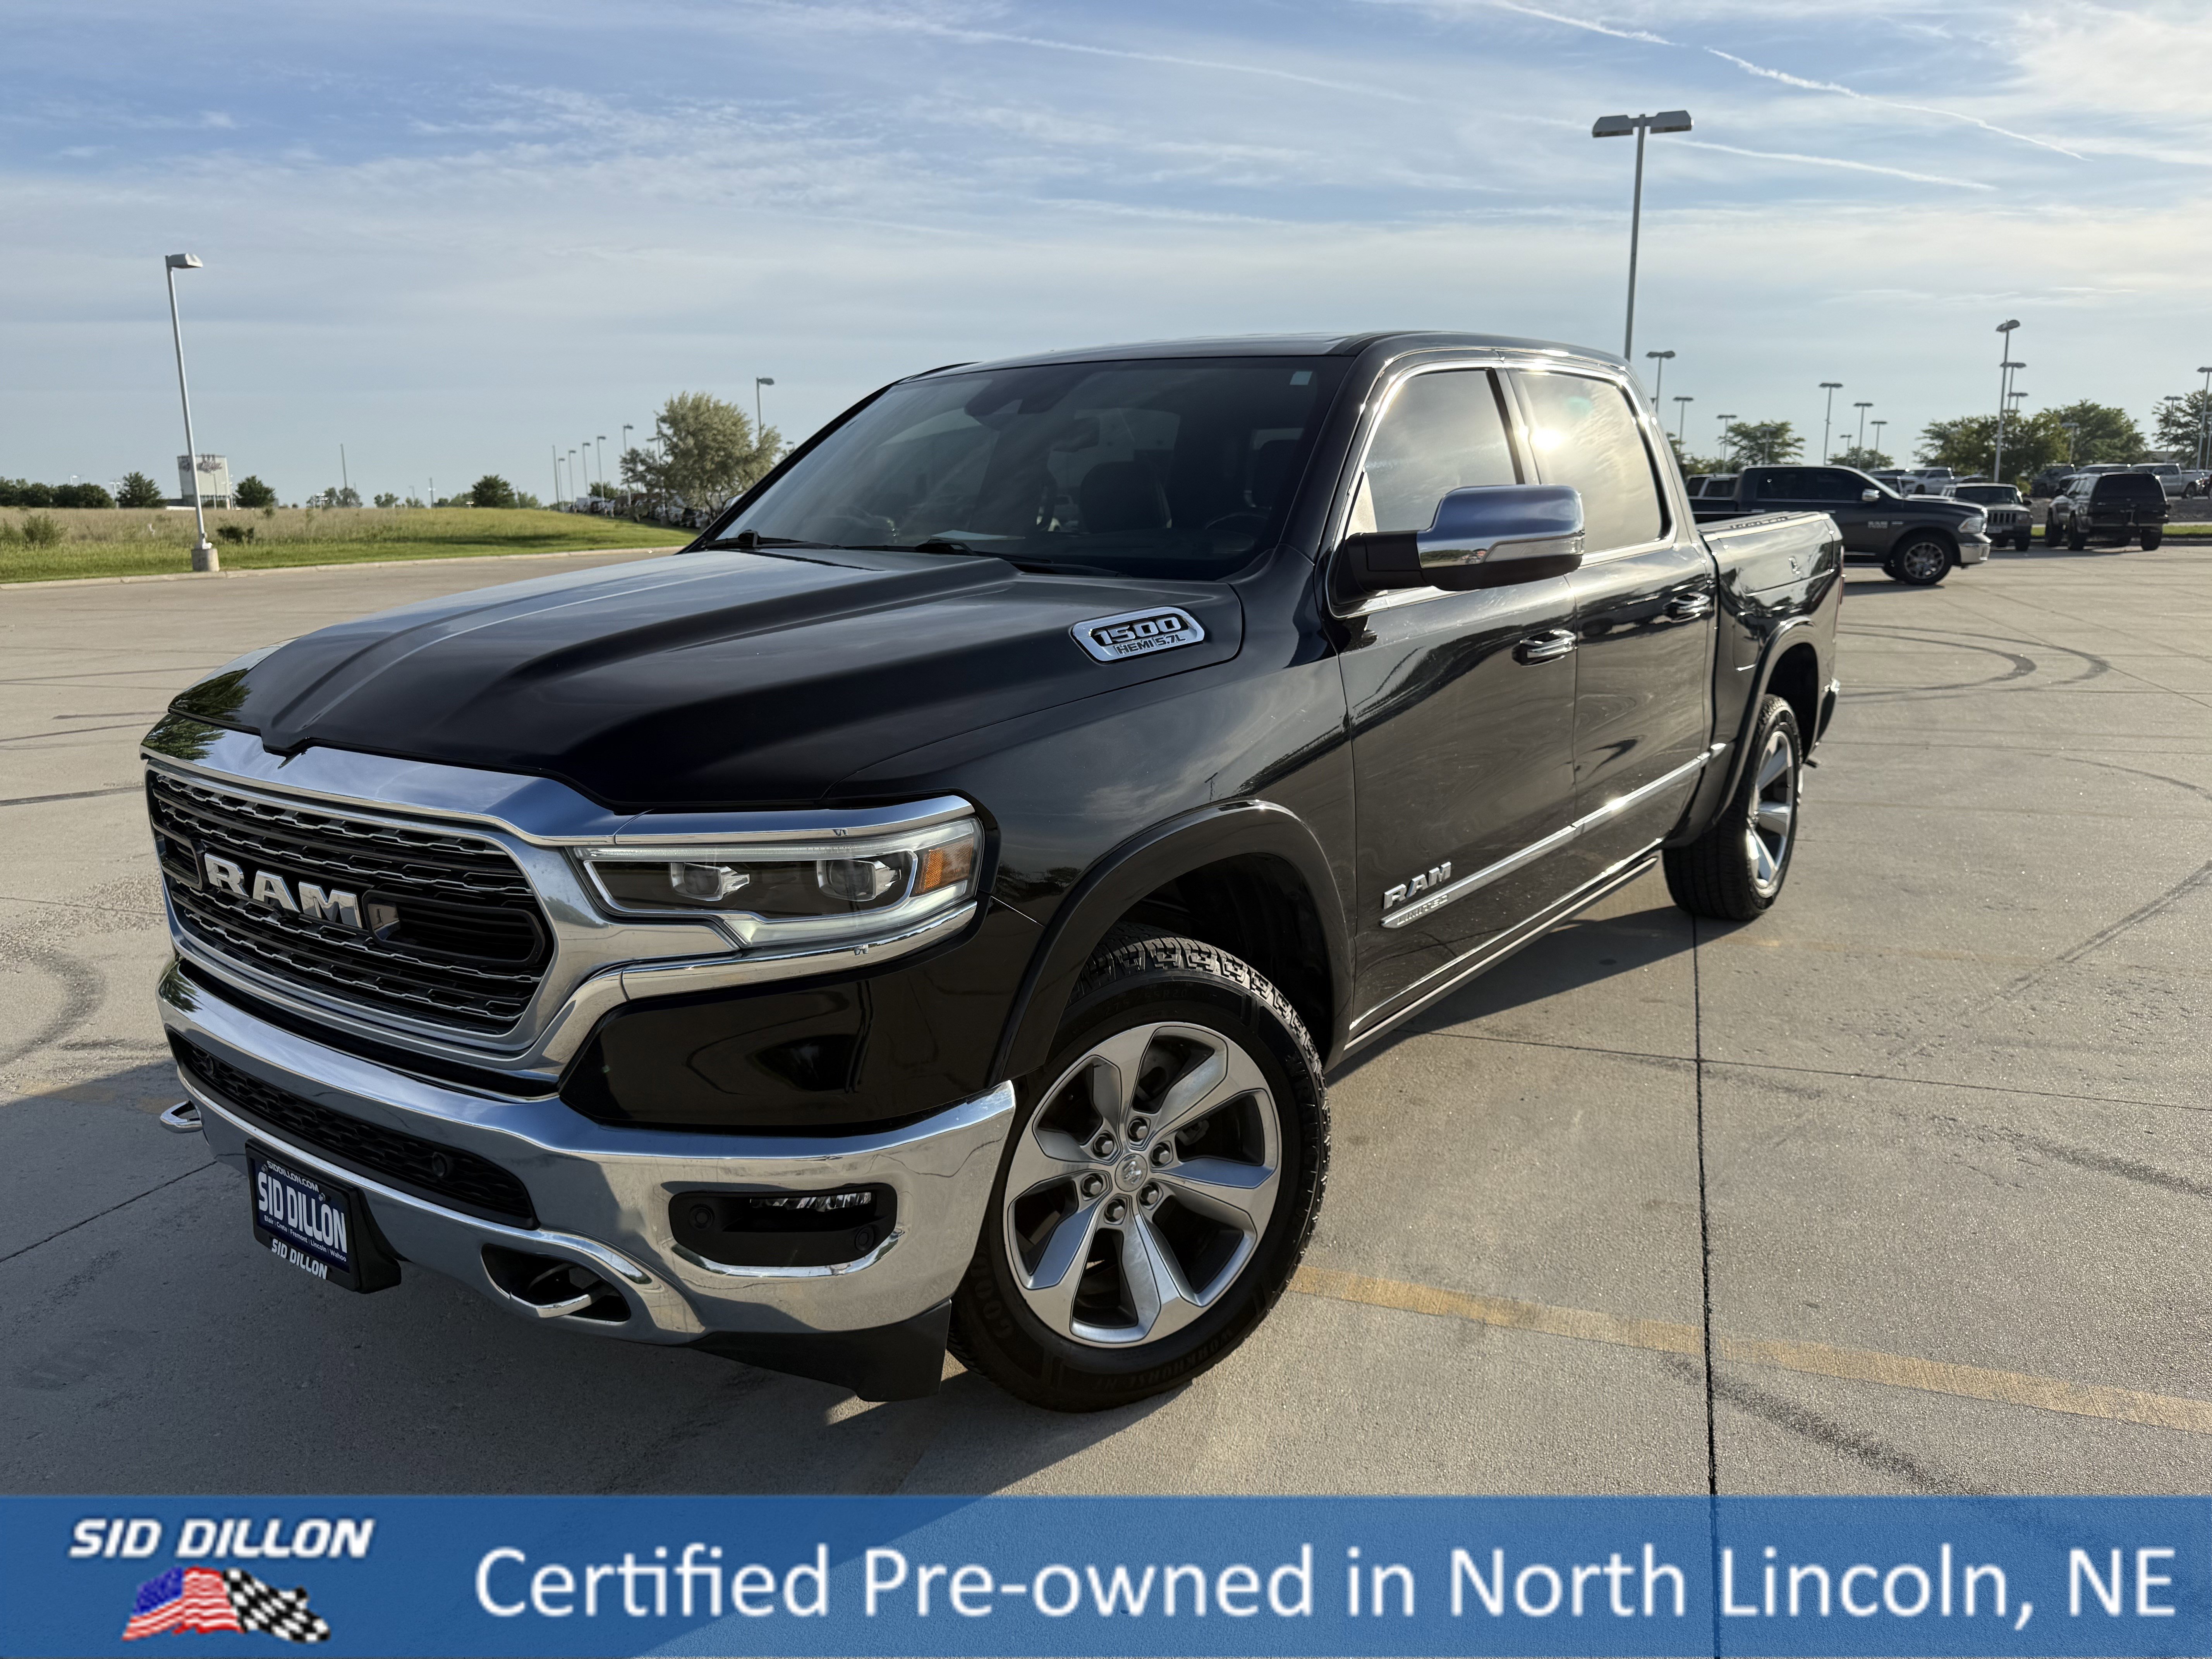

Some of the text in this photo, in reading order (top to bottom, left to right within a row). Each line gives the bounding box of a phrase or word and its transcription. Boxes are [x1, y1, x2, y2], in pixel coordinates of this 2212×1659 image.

[1094, 617, 1181, 645] 1500
[1116, 634, 1186, 655] HEMI 5.7L
[204, 853, 362, 929] RAM
[1383, 861, 1451, 910] RAM
[266, 1160, 319, 1193] SIDDILLON.COM
[258, 1171, 347, 1254] SID DILLON
[271, 1238, 328, 1280] SID DILLON
[290, 1229, 308, 1243] Fremont
[310, 1240, 327, 1253] Lincoln
